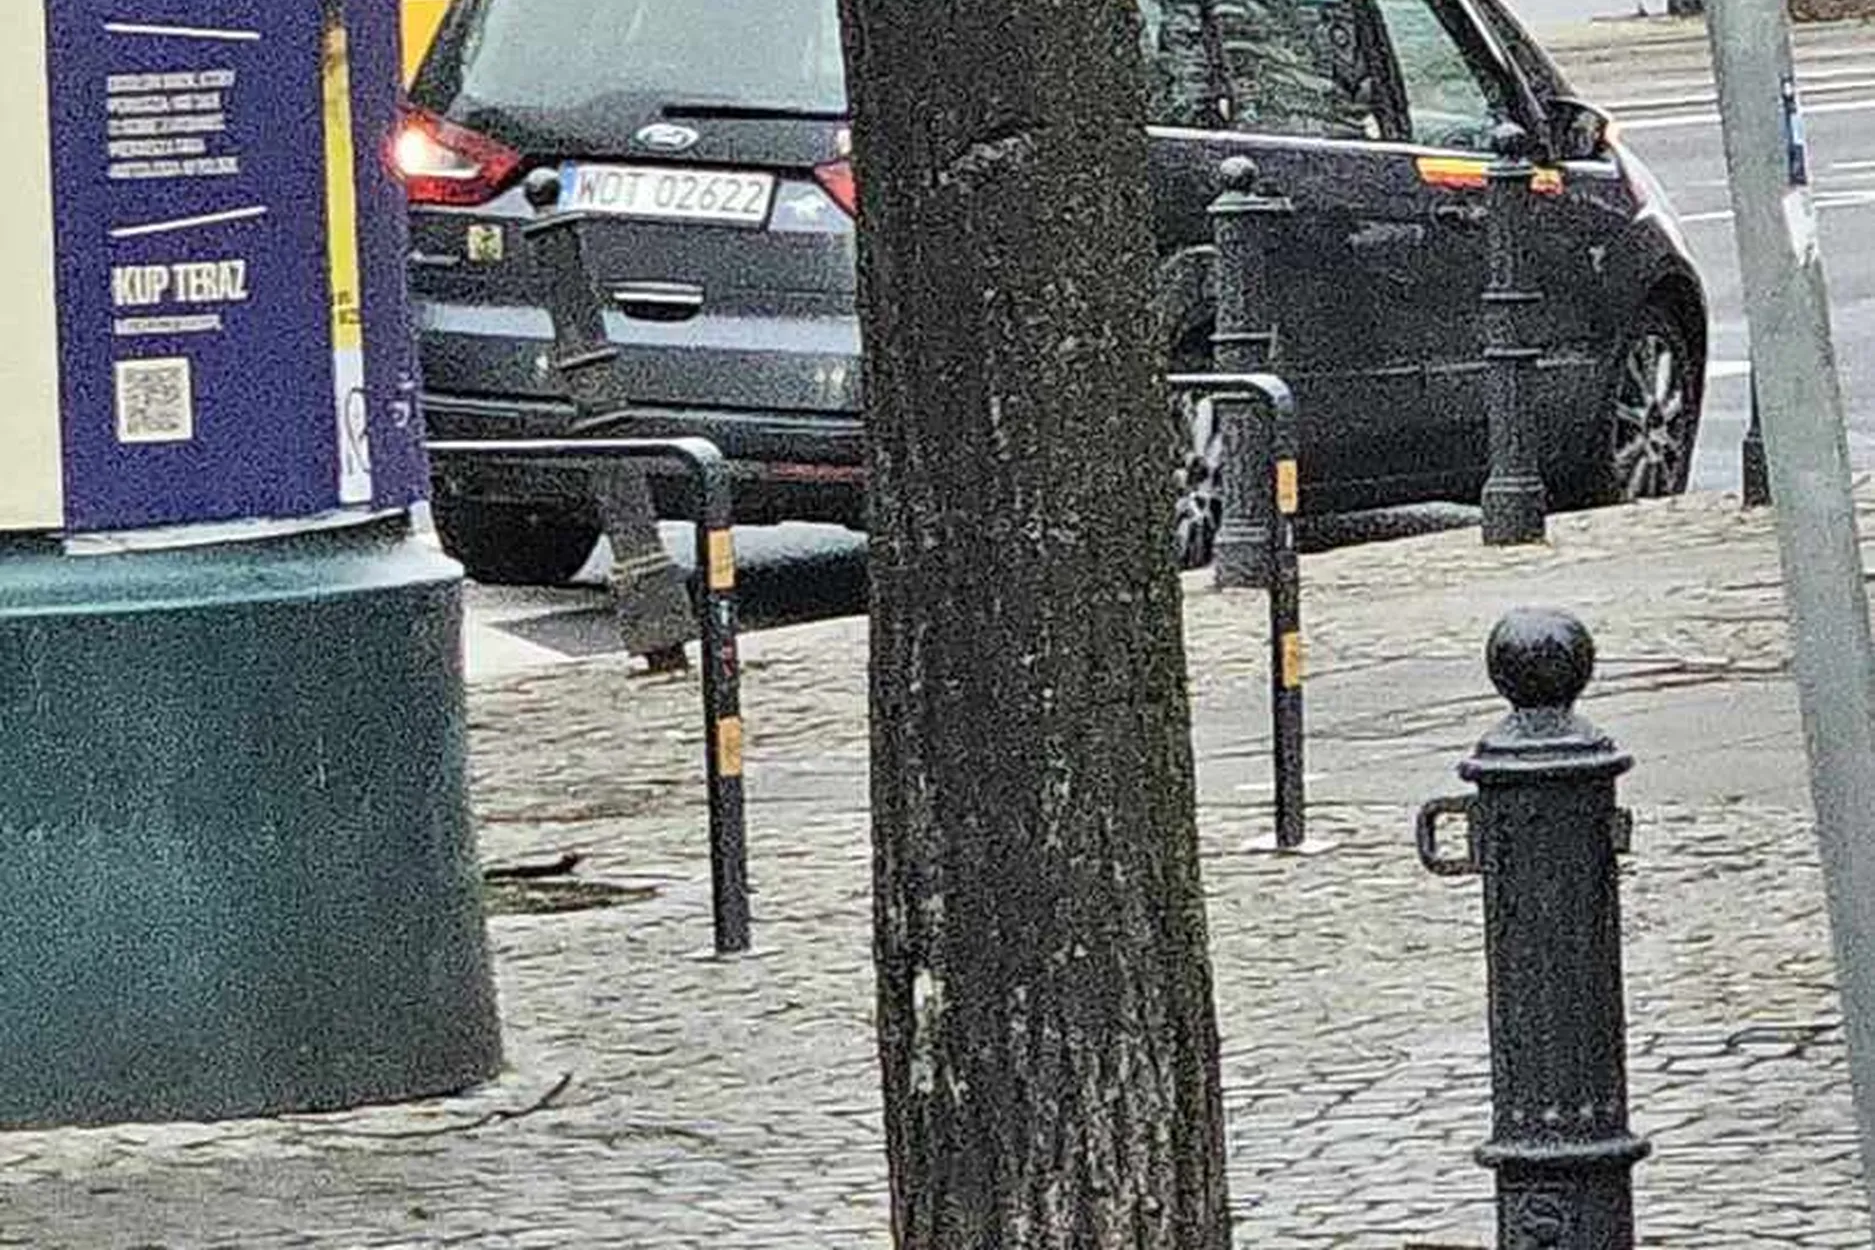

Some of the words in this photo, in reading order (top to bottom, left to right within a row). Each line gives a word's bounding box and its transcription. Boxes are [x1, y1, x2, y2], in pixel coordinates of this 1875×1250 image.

[656, 174, 765, 216] 02622
[111, 264, 170, 306] KUP
[171, 259, 249, 302] TERAZ
